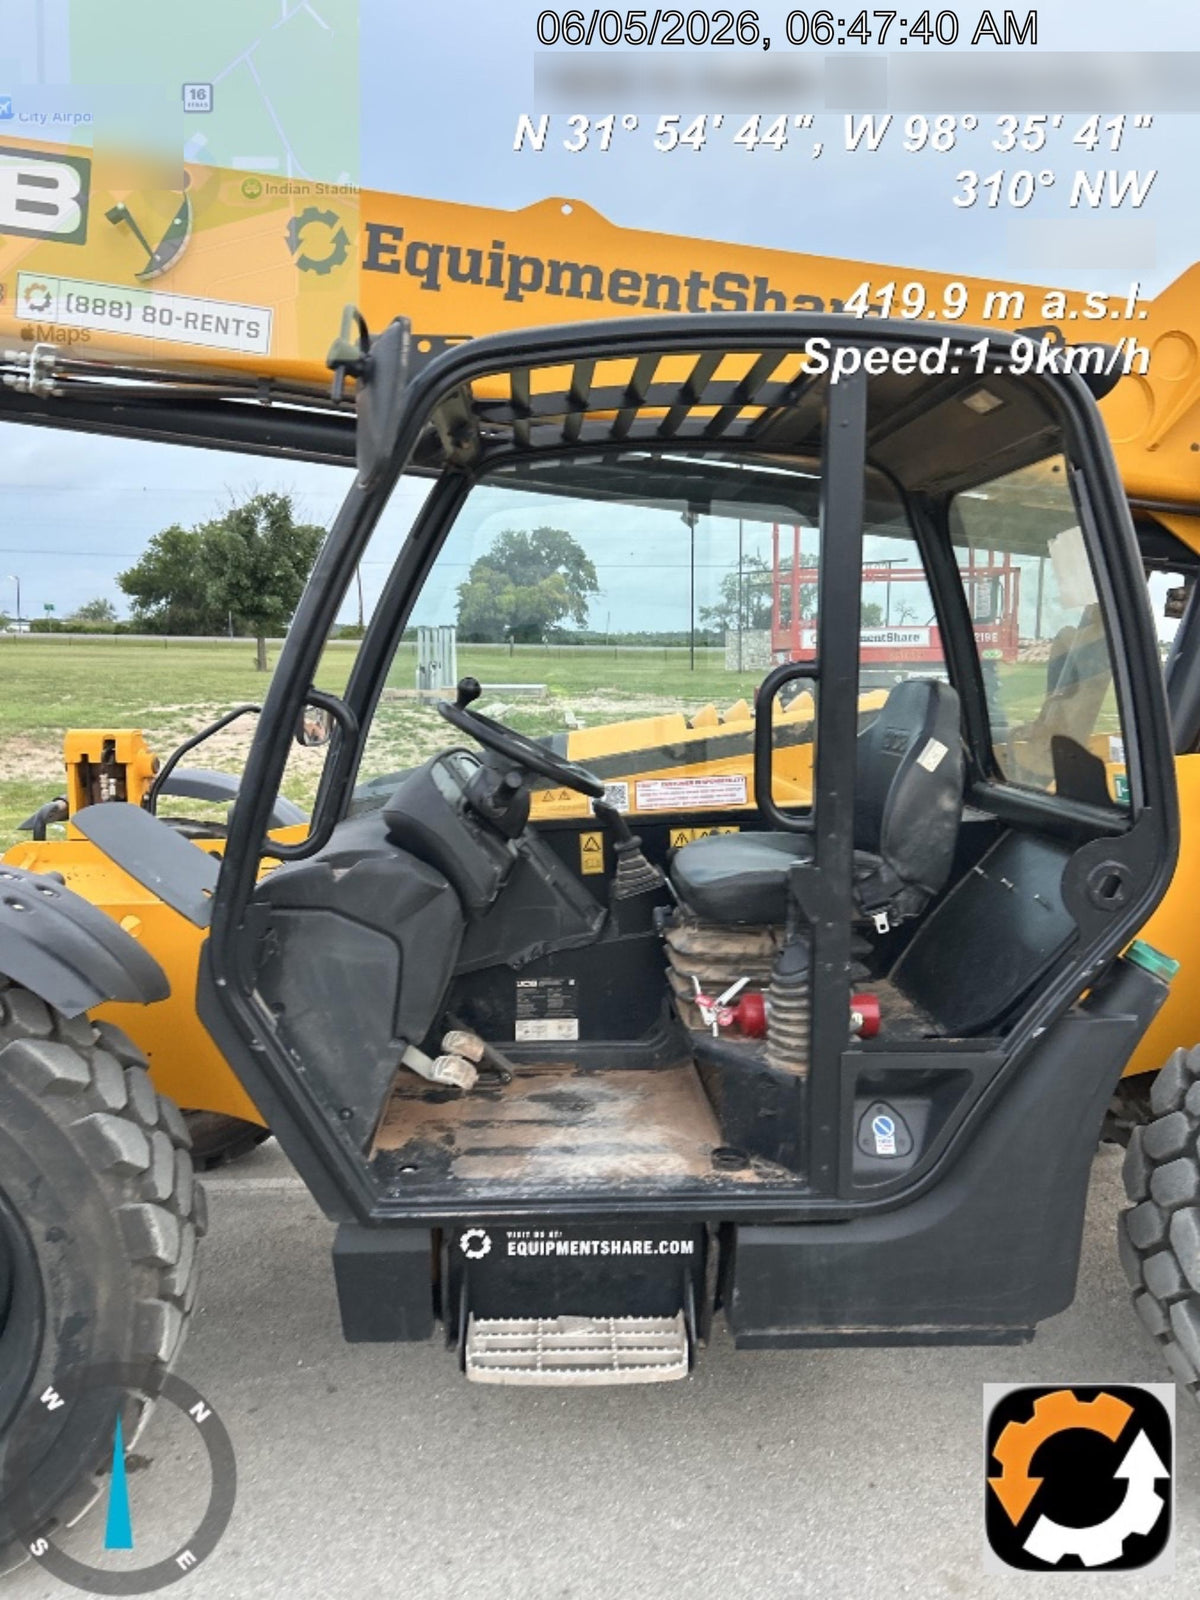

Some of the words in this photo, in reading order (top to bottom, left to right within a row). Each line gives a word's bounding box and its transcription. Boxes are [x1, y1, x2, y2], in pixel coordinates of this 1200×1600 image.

[362, 221, 884, 313] EquipmentSha
[65, 292, 132, 320] (888)
[142, 304, 260, 339] 80-RENTS
[507, 1240, 694, 1257] EQUIPMENTSHARE.COM
